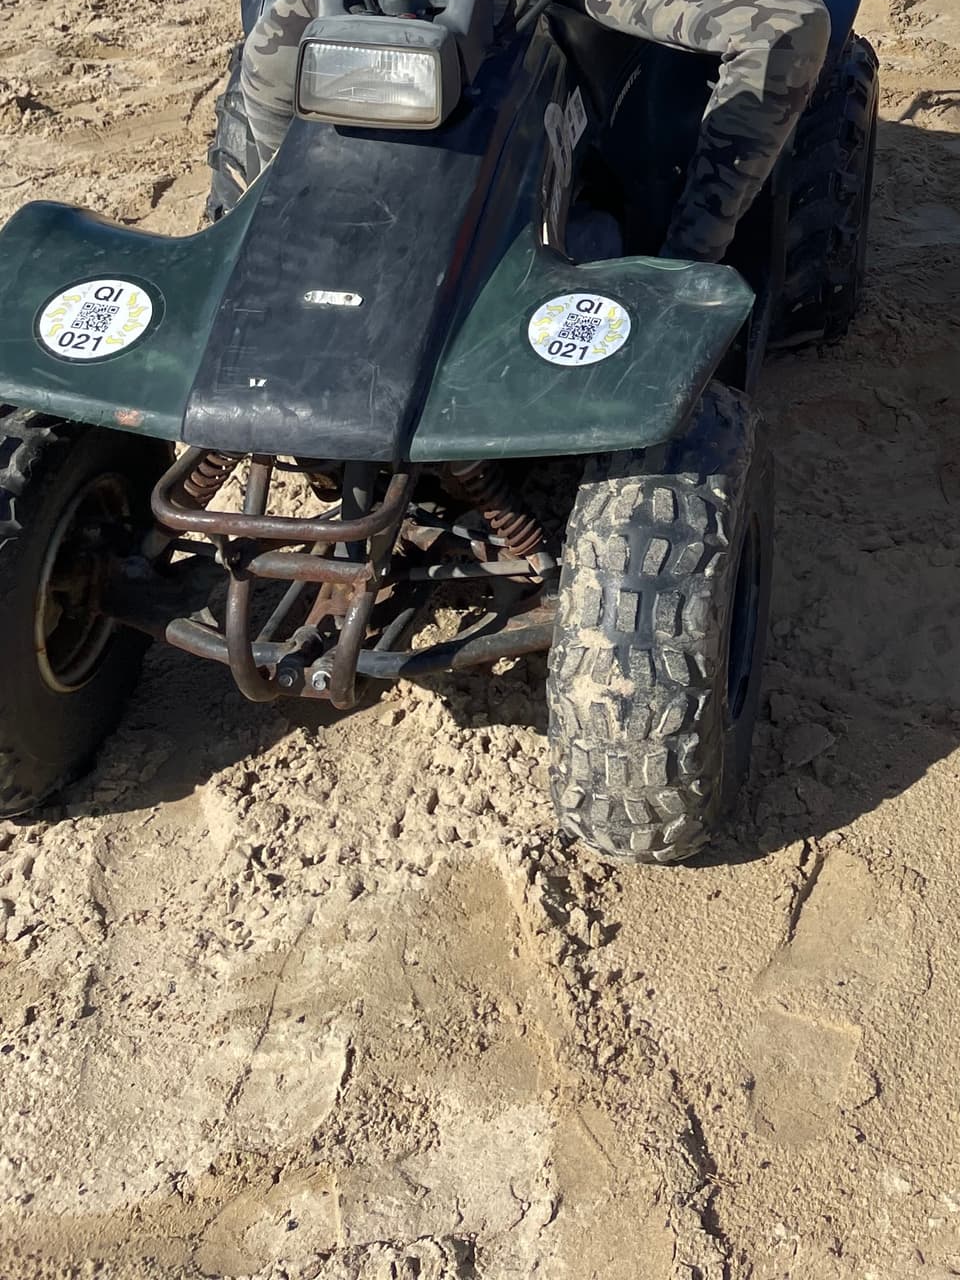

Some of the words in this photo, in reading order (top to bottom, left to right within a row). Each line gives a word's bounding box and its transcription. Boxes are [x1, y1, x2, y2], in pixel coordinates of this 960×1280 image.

[94, 286, 124, 302] QI
[575, 299, 604, 315] QI
[58, 331, 103, 352] 021
[547, 340, 589, 361] 021
